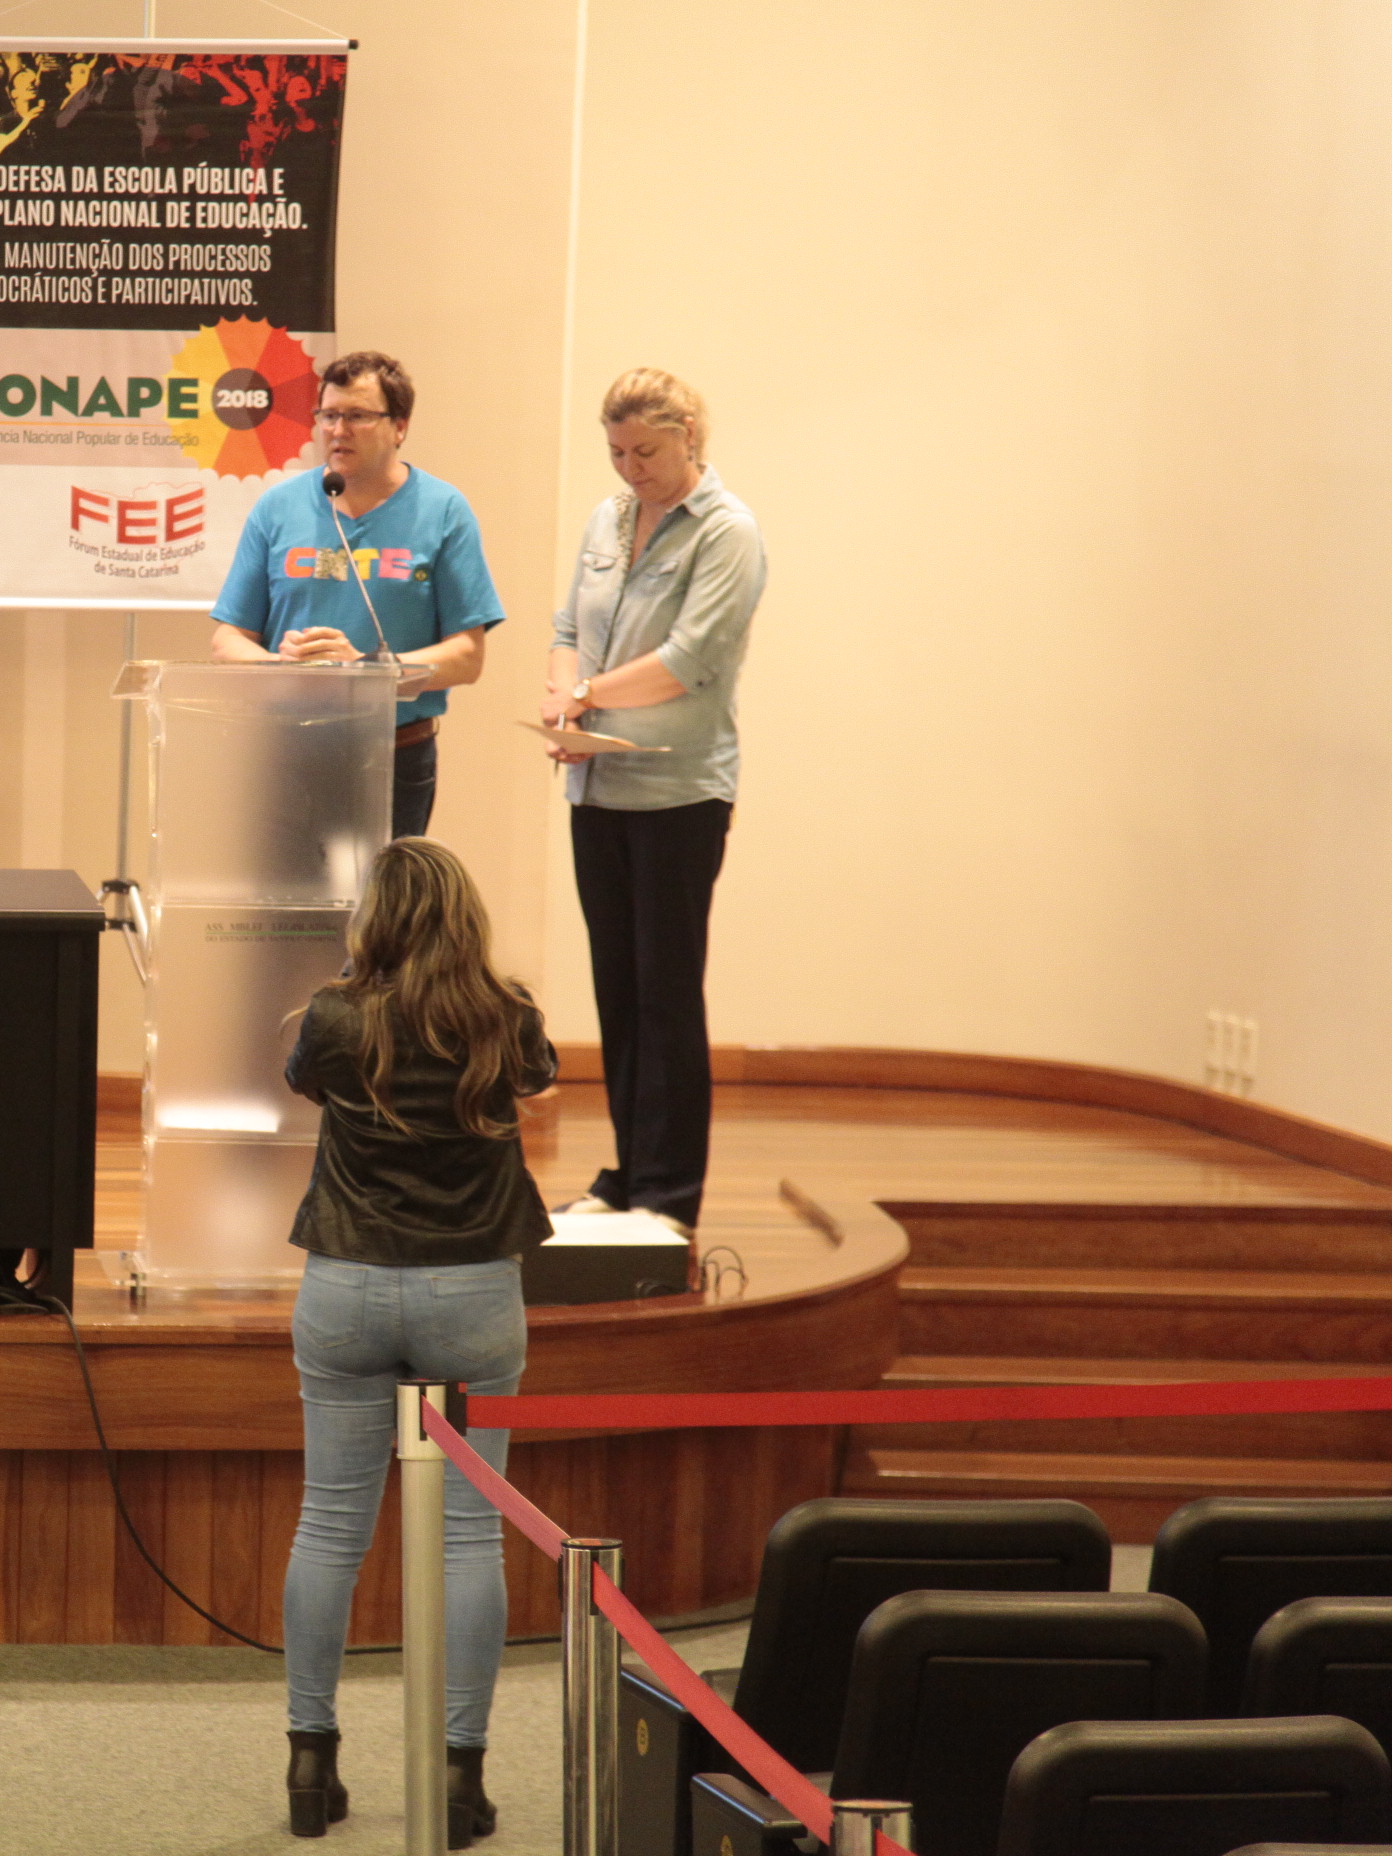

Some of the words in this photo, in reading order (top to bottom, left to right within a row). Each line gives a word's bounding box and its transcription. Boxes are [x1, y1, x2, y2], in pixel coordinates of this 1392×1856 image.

[72, 166, 98, 193] DA
[103, 167, 178, 194] ESCOLA
[182, 161, 268, 195] PÚBLICA
[273, 168, 285, 195] E
[60, 200, 161, 228] NACIONAL
[166, 201, 190, 228] DE
[195, 197, 308, 238] EDUCAÇÃO.
[4, 239, 123, 277] MANUTENÇÃO
[128, 243, 164, 271] DOS
[168, 244, 271, 272] PROCESSOS
[97, 276, 107, 304] E
[111, 277, 258, 306] PARTICIPATIVOS.
[216, 389, 269, 408] 2018
[23, 430, 72, 444] Nacional
[77, 431, 121, 448] Popular
[125, 433, 138, 446] de
[142, 433, 199, 449] Educação
[71, 485, 205, 545] FEE
[69, 536, 100, 557] Fórum
[101, 546, 144, 561] Estadual
[145, 550, 157, 561] de
[160, 540, 206, 561] Educação
[284, 547, 413, 582] CNTE
[94, 561, 106, 574] de
[109, 564, 135, 578] Santa
[138, 563, 179, 578] Catarina
